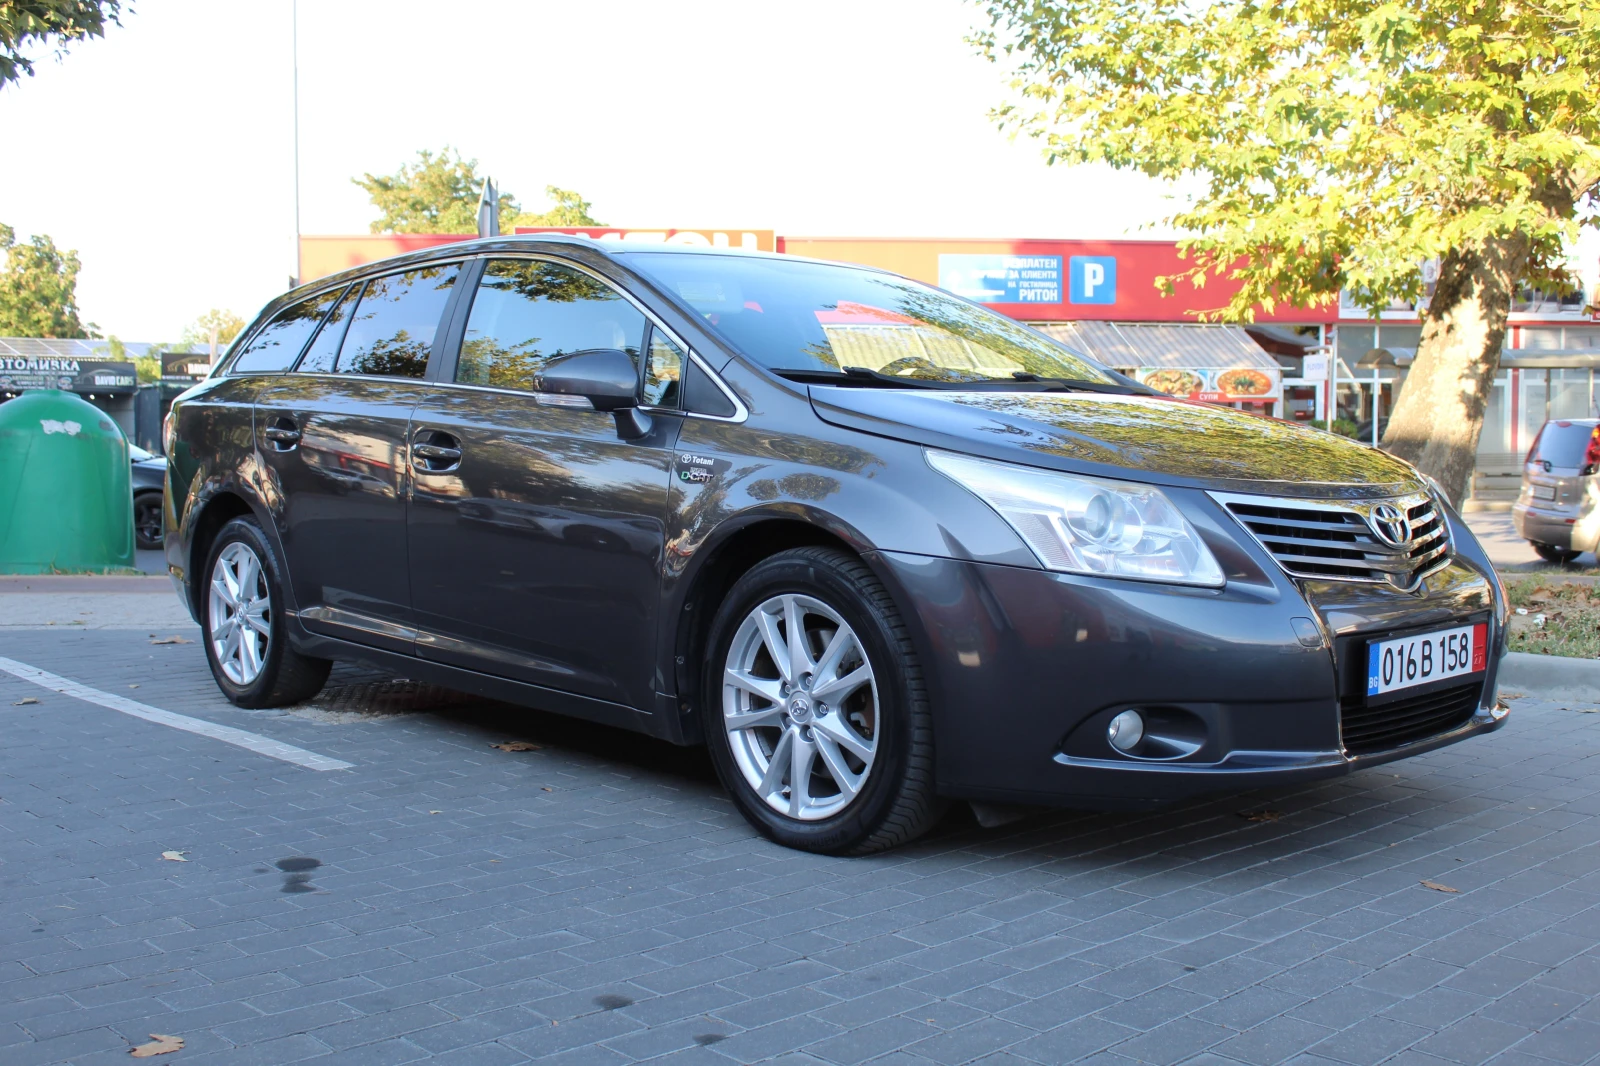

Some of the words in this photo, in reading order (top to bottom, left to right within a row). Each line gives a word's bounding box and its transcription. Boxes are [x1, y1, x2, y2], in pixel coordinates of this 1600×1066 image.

[1003, 258, 1057, 268] ПЛАТЕН
[1009, 270, 1019, 278] ЗА
[1021, 270, 1057, 278] КЛИЕНТИ
[1084, 263, 1104, 297] P
[1019, 289, 1058, 301] РИТОН
[116, 376, 135, 387] CARS
[1199, 393, 1219, 401] СУПИ
[692, 456, 714, 466] Totani
[1368, 676, 1379, 689] BG
